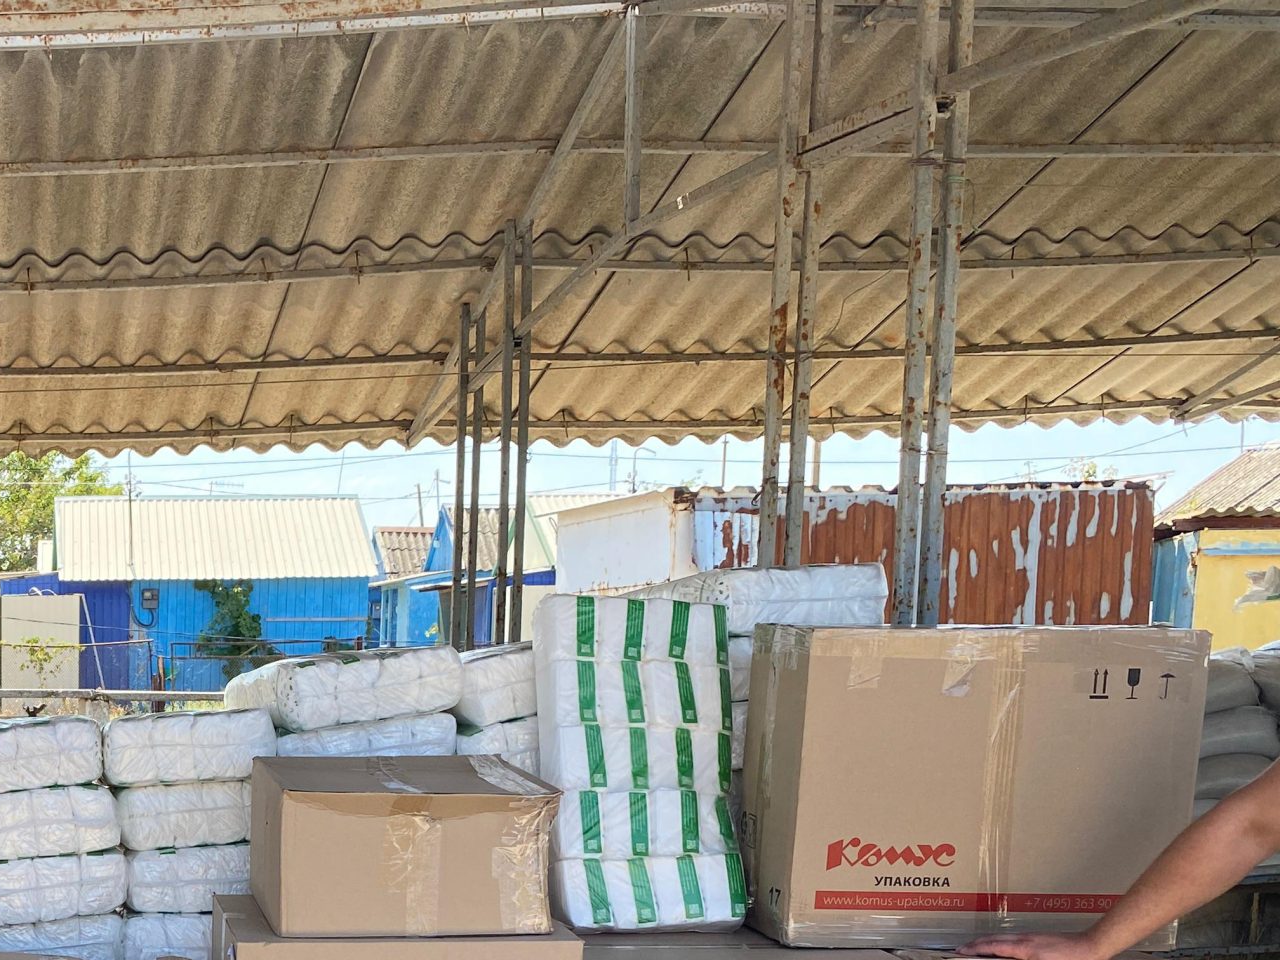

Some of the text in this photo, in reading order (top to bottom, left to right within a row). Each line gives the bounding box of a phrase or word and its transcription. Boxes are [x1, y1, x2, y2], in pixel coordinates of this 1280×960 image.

[825, 837, 956, 871] Комус
[874, 876, 951, 888] УПАКОВКА
[769, 886, 781, 906] 17
[823, 894, 965, 908] www.komus-upakovka.ru
[1024, 897, 1112, 910] +7 (495) 363 90
